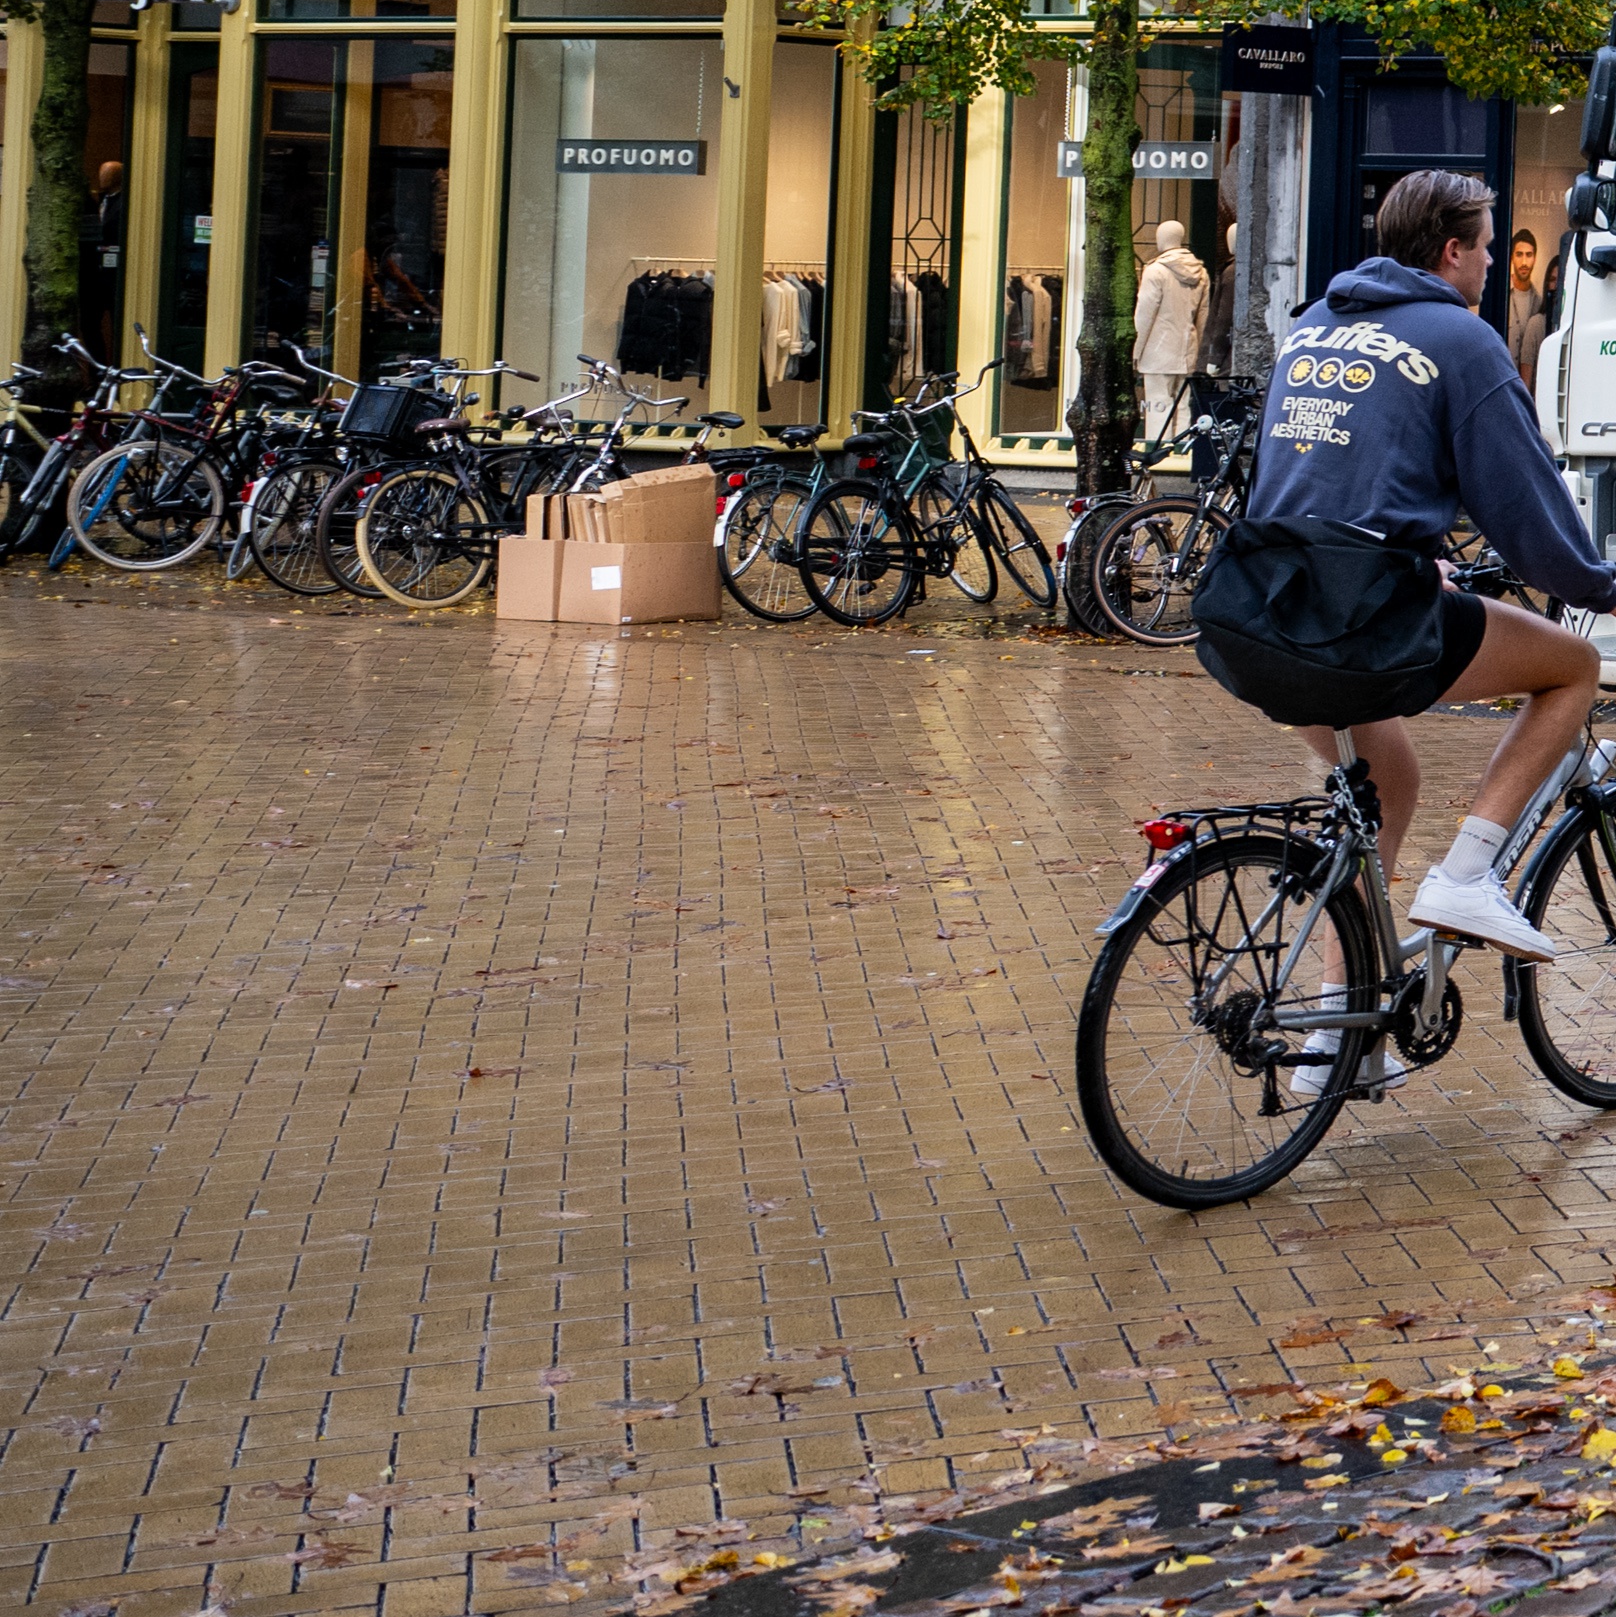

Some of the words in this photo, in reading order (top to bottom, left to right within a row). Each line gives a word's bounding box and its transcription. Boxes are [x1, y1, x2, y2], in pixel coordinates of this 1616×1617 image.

[1238, 48, 1305, 63] CAVALLARO
[563, 148, 695, 166] PROFUOMO
[1065, 150, 1209, 169] PUOMO
[1282, 397, 1354, 417] EVERYDAY
[1288, 411, 1335, 428] URBAN
[1270, 423, 1350, 445] AESTHETICS
